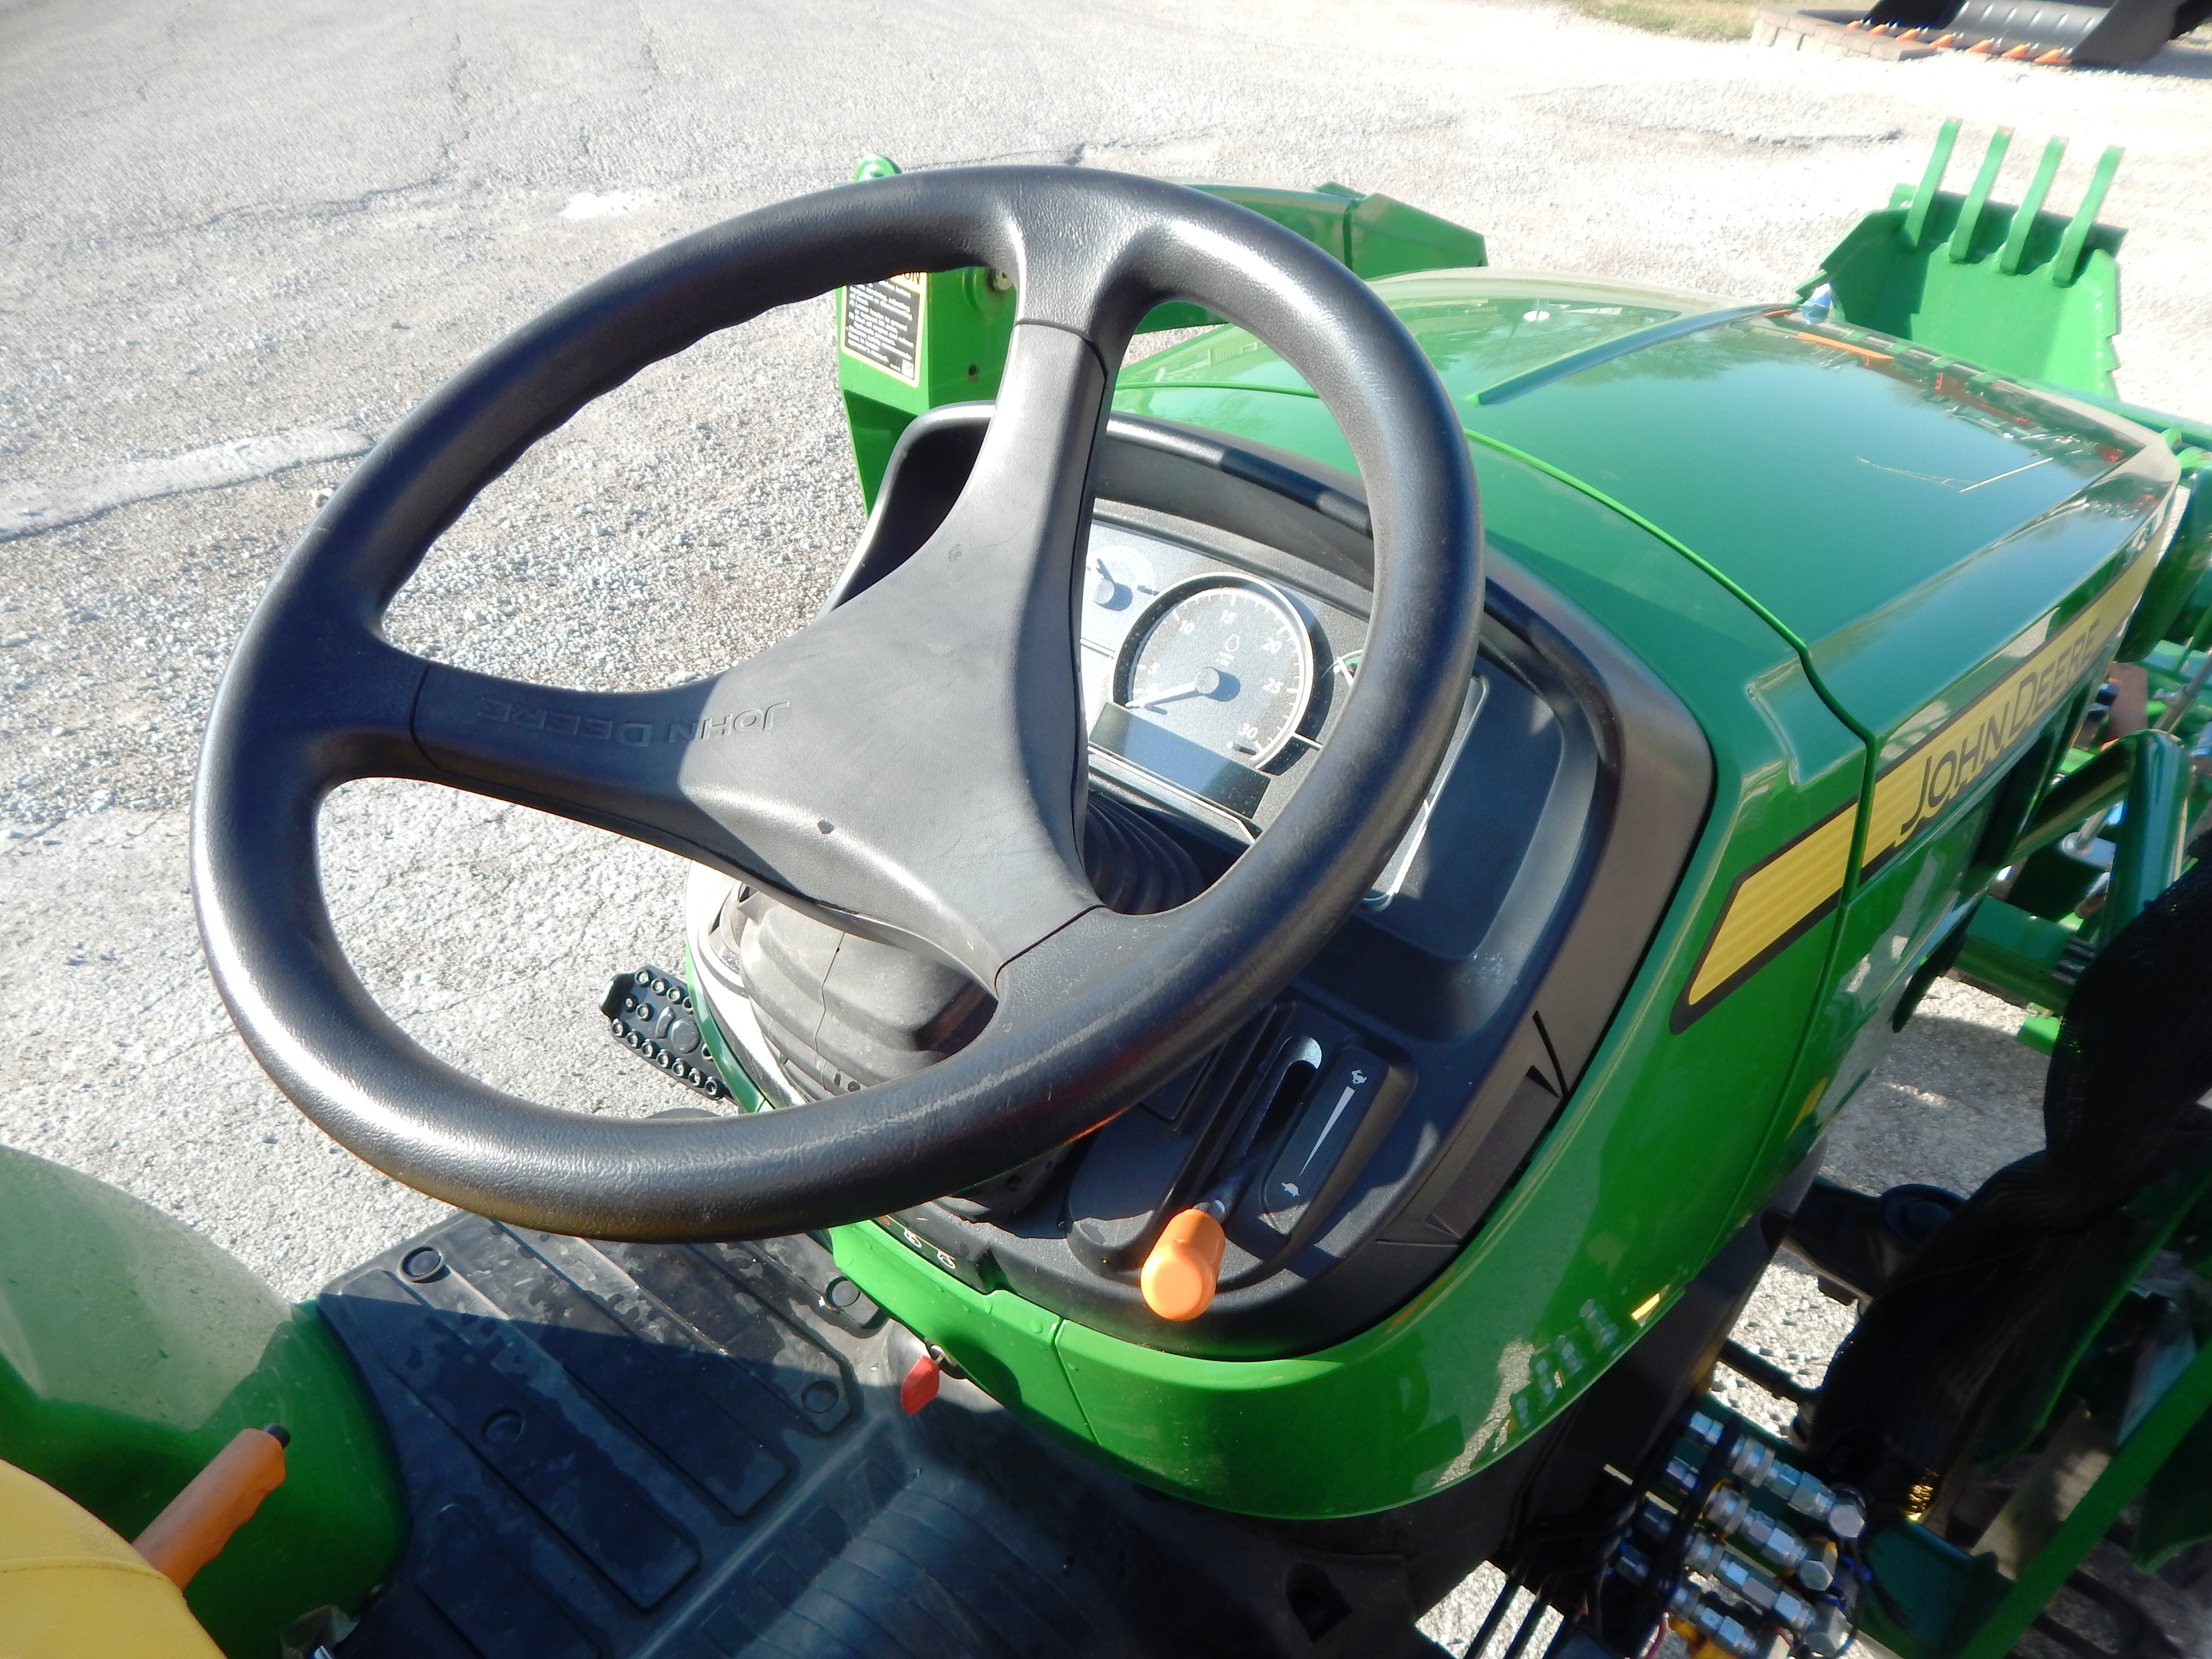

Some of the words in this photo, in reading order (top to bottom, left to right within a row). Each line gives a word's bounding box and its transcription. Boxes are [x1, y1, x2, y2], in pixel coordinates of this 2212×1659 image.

[1220, 609, 1237, 624] 15
[1178, 619, 1195, 634] 10
[1262, 637, 1282, 653] 20
[1147, 662, 1160, 675] 5
[1262, 677, 1284, 694] 25
[477, 695, 652, 747] DEERE
[668, 699, 790, 743] JOHN
[1900, 701, 2010, 836] JOHN
[2008, 618, 2100, 740] DEERE
[1238, 722, 1258, 739] 30
